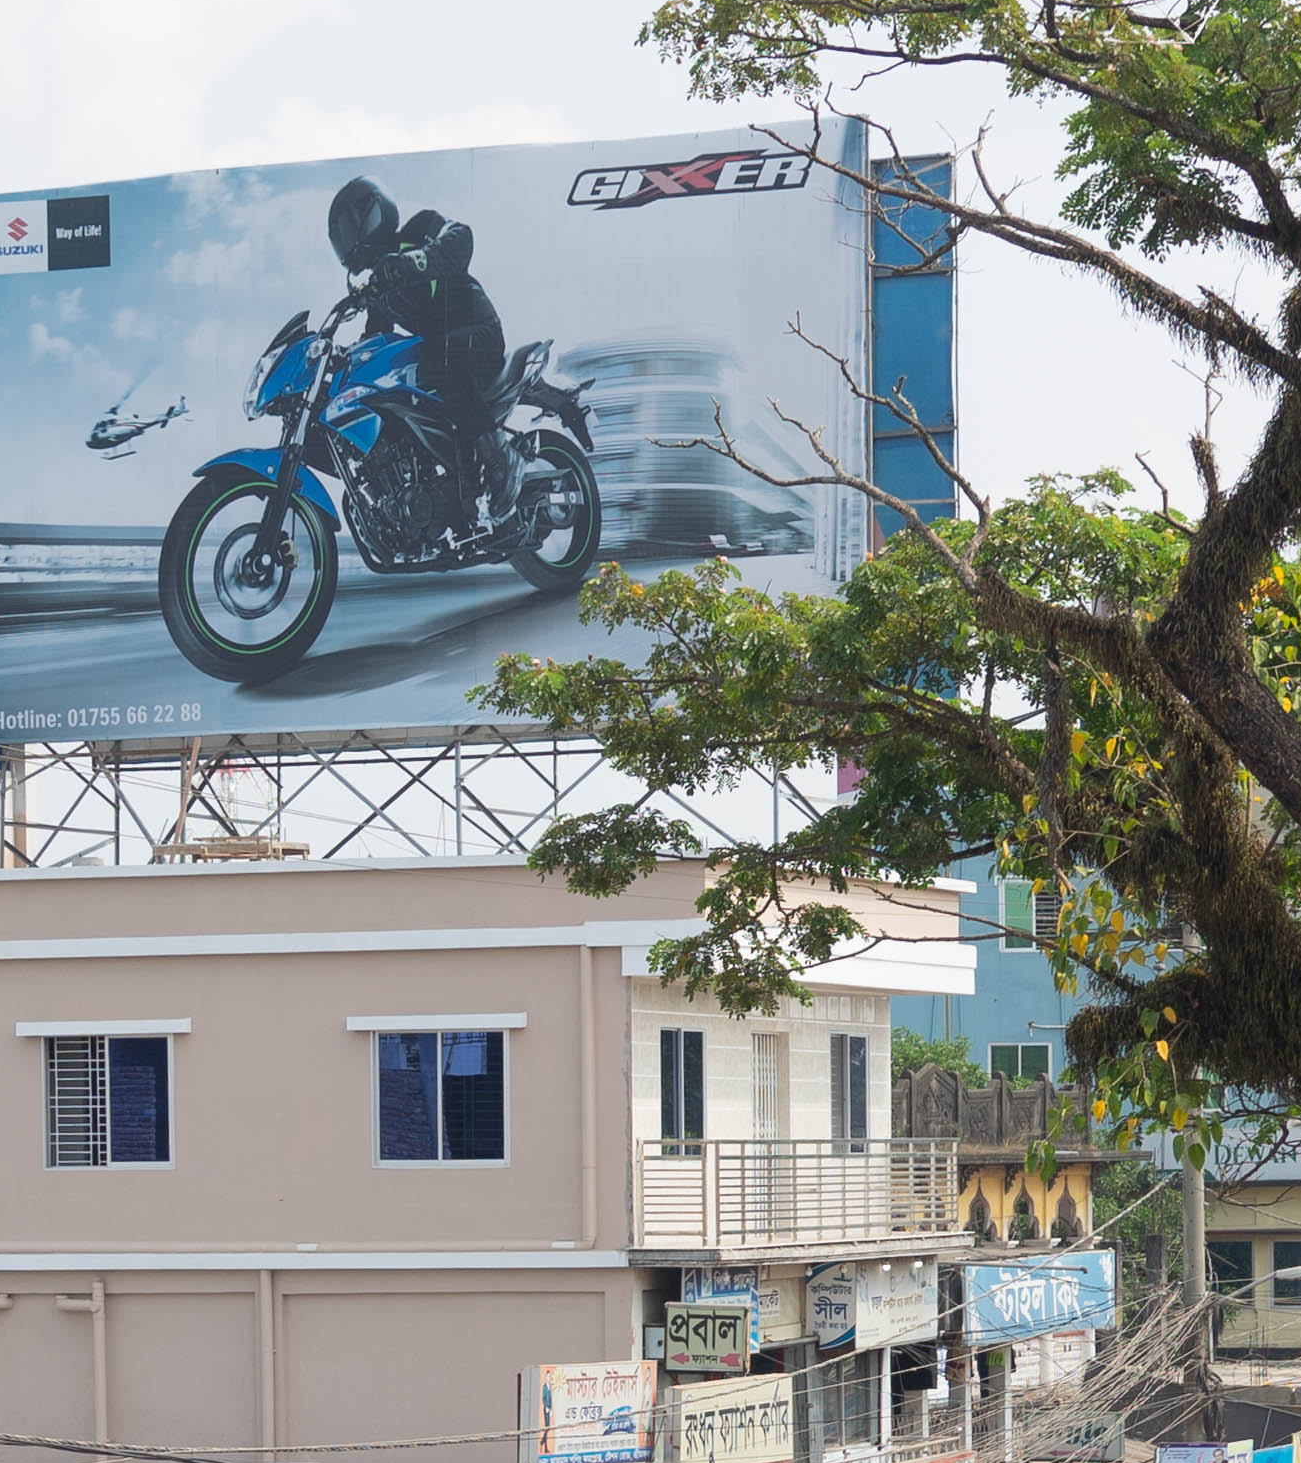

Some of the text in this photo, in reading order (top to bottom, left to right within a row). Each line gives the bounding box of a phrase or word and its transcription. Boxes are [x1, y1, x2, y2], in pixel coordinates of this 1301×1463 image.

[570, 152, 813, 205] GIXER
[55, 227, 73, 240] Way
[74, 225, 83, 237] of
[68, 707, 120, 727] 01755
[127, 705, 148, 725] 66
[154, 704, 174, 723] 22
[180, 702, 201, 722] 88
[669, 1310, 741, 1351] প্রবাল
